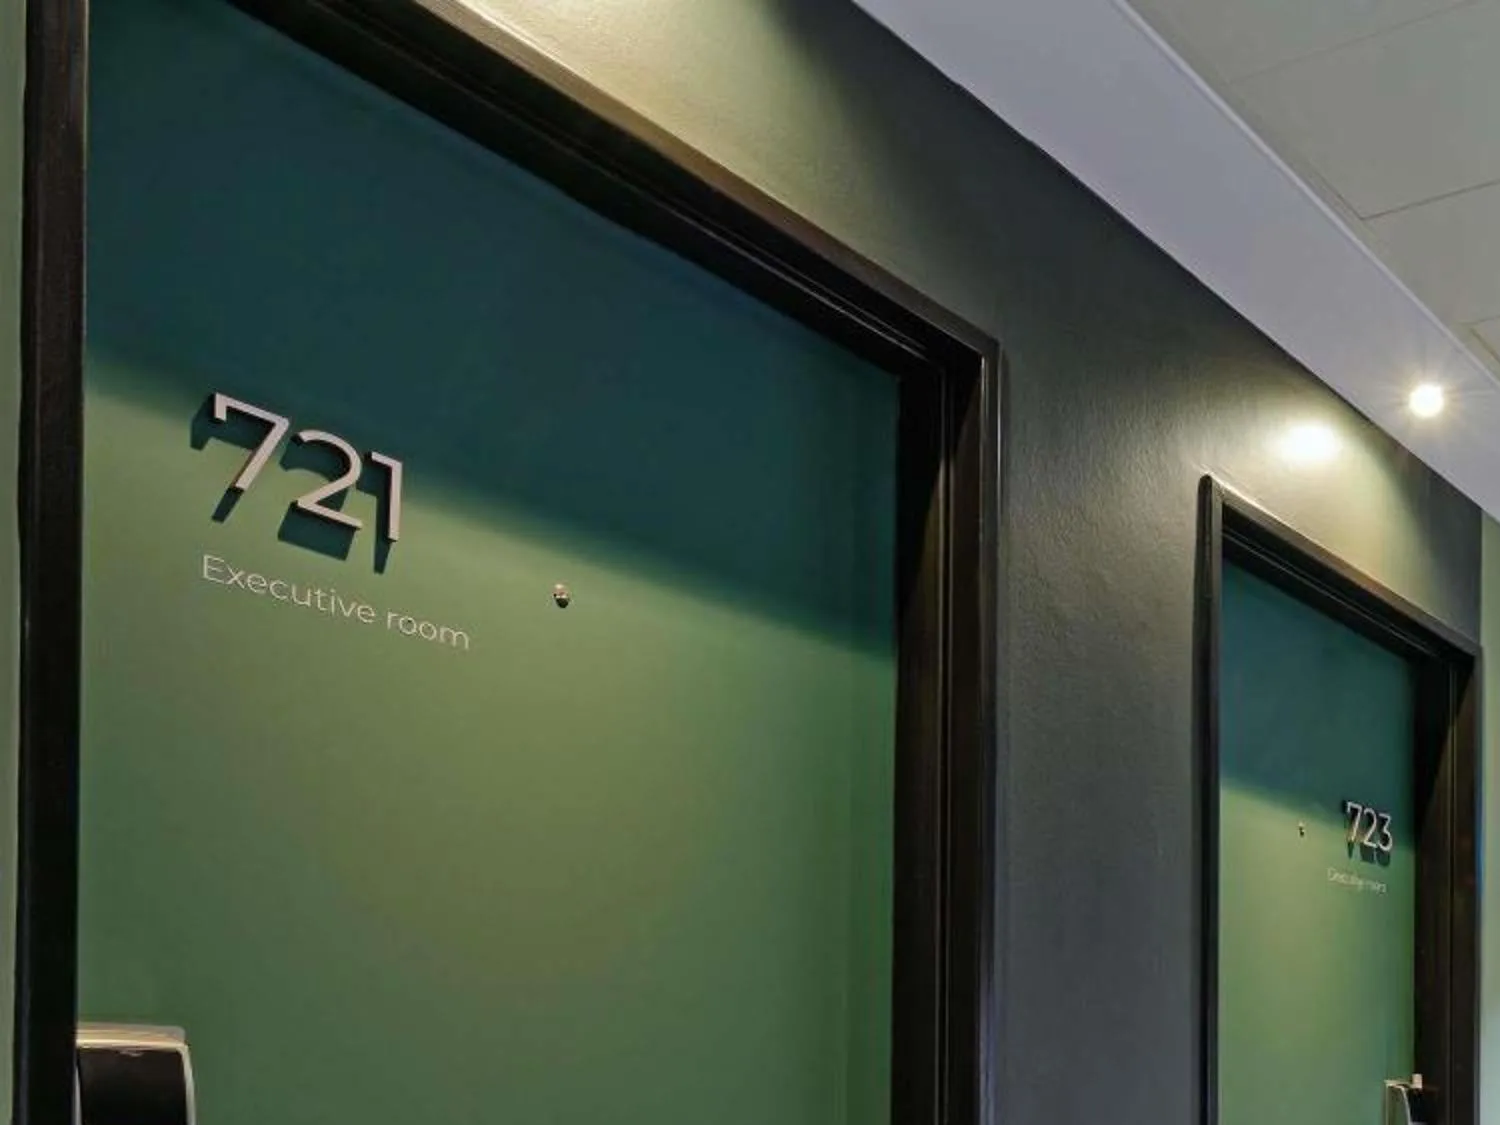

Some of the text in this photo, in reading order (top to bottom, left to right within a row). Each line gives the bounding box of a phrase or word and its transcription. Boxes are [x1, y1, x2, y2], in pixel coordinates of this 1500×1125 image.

[212, 391, 404, 542] 721
[201, 554, 471, 651] Executive room
[1346, 801, 1393, 852] 723
